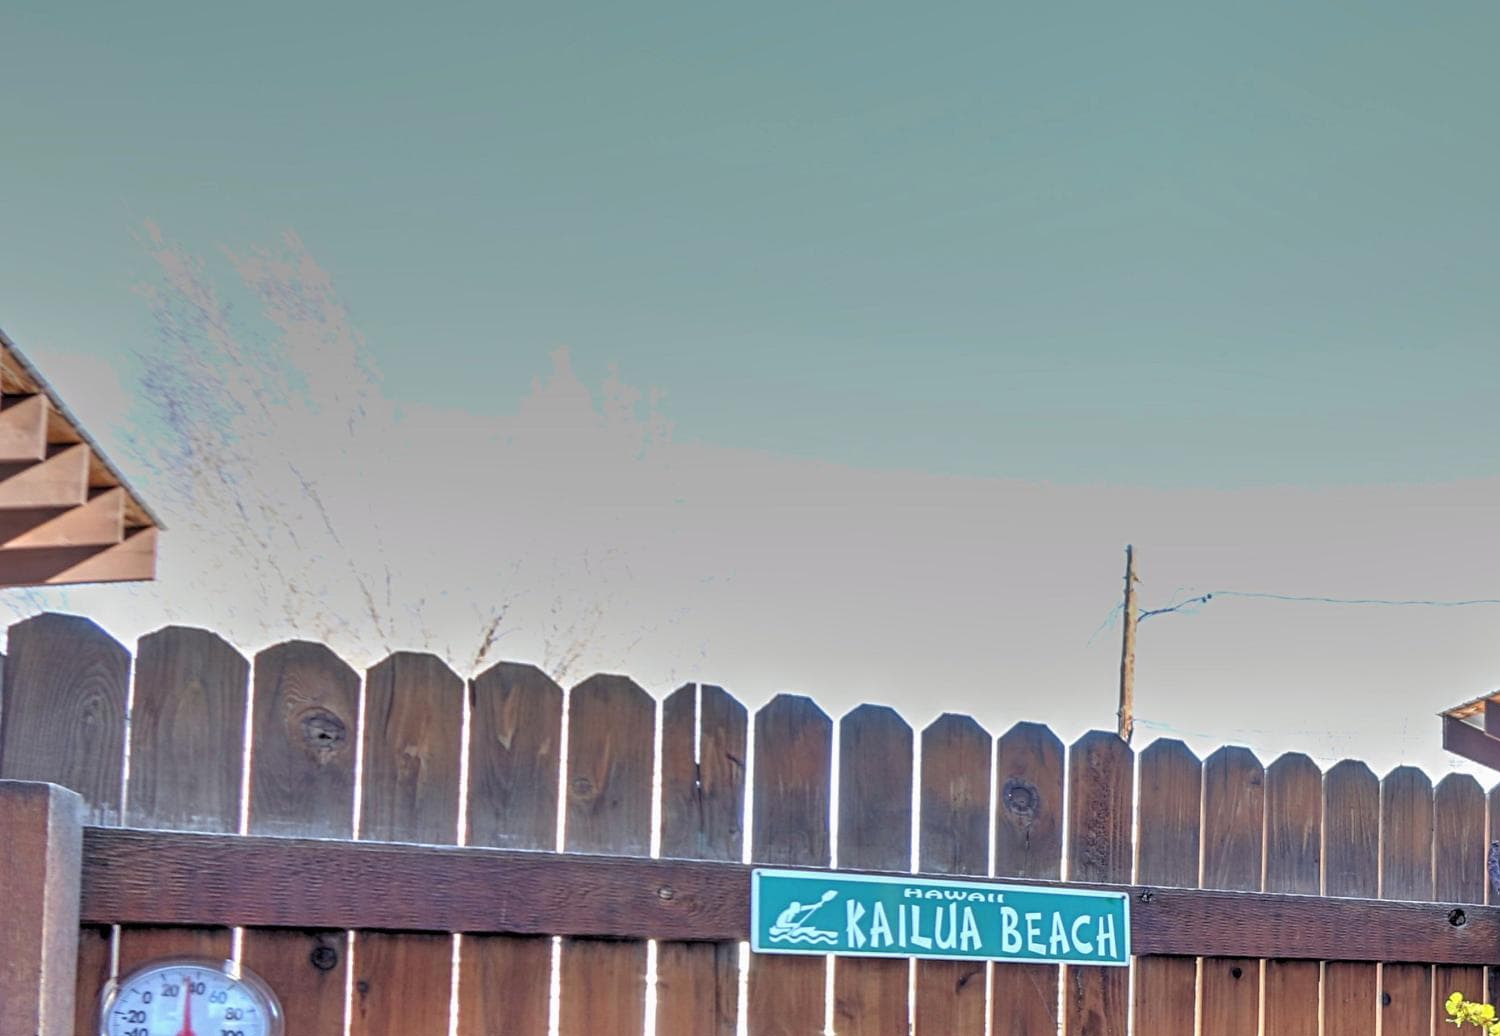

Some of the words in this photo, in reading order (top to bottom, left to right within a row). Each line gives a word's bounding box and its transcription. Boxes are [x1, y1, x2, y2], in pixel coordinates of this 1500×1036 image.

[903, 887, 1004, 904] HAWAII
[846, 898, 983, 952] KAILUA
[1000, 905, 1118, 959] BEACH
[161, 983, 180, 998] 20
[189, 982, 207, 996] 40
[142, 991, 153, 1005] 0
[209, 991, 228, 1004] 60
[121, 1009, 147, 1024] -20
[224, 1007, 244, 1021] 80
